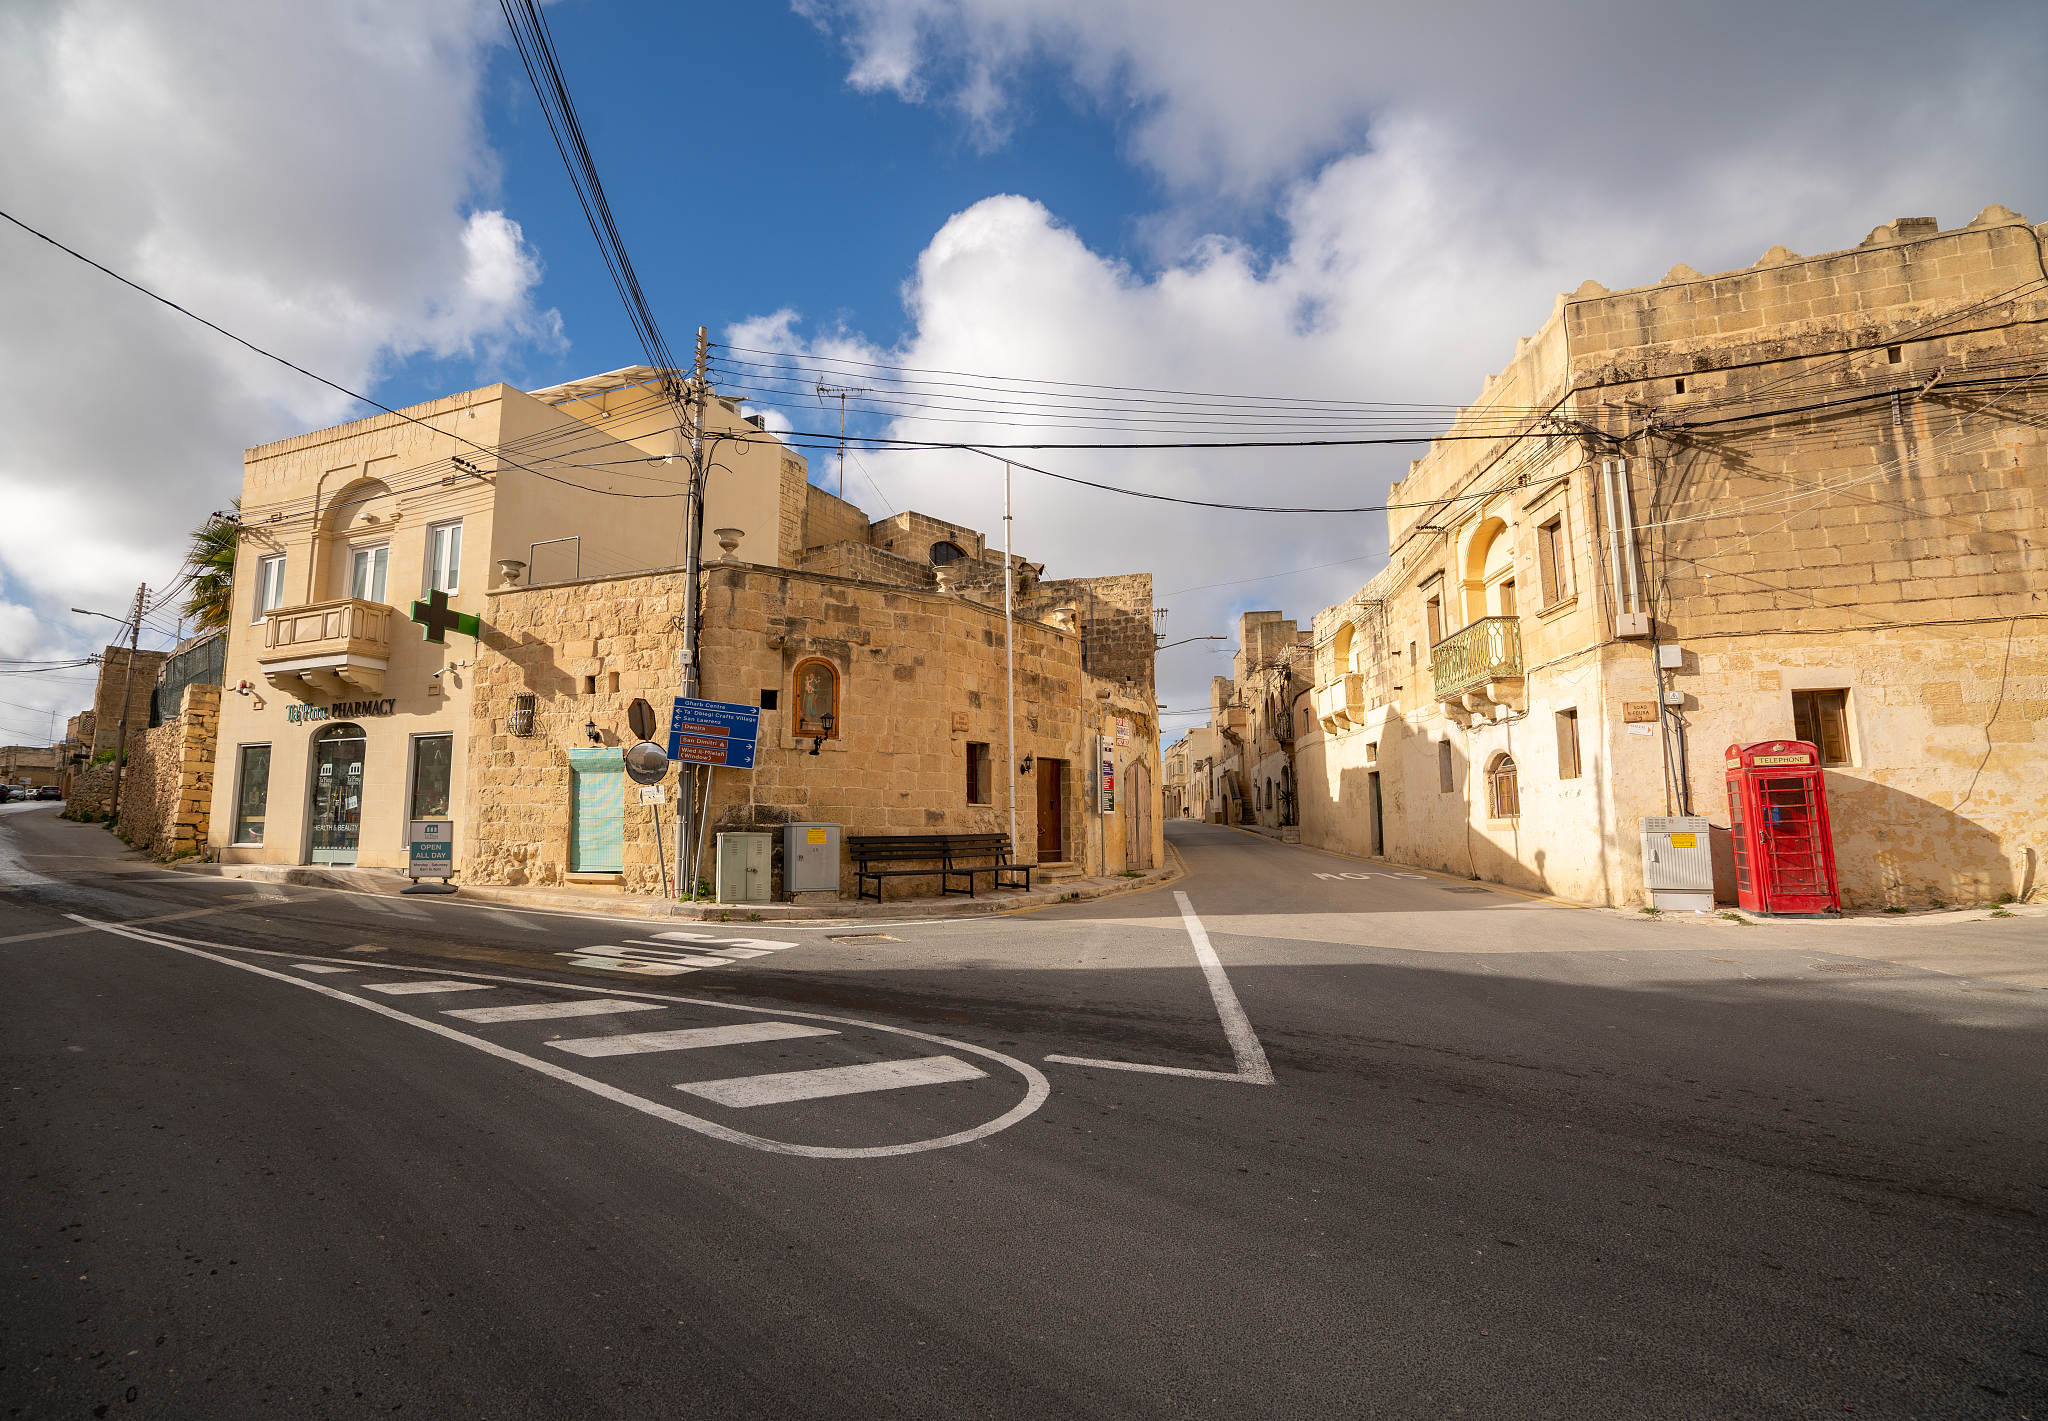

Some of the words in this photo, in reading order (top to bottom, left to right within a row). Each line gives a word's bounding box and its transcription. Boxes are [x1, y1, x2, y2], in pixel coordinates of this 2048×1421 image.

[331, 698, 396, 718] PHARMACY
[715, 712, 734, 720] Crafts
[735, 715, 757, 723] Village
[696, 738, 717, 746] Dimitri
[680, 753, 712, 761] (Window)
[1759, 756, 1805, 764] TELEPHONE
[314, 824, 333, 832] HEALTH
[337, 824, 359, 832] BEAUTY
[1311, 872, 1428, 881] SLOW
[553, 931, 801, 976] STOP
